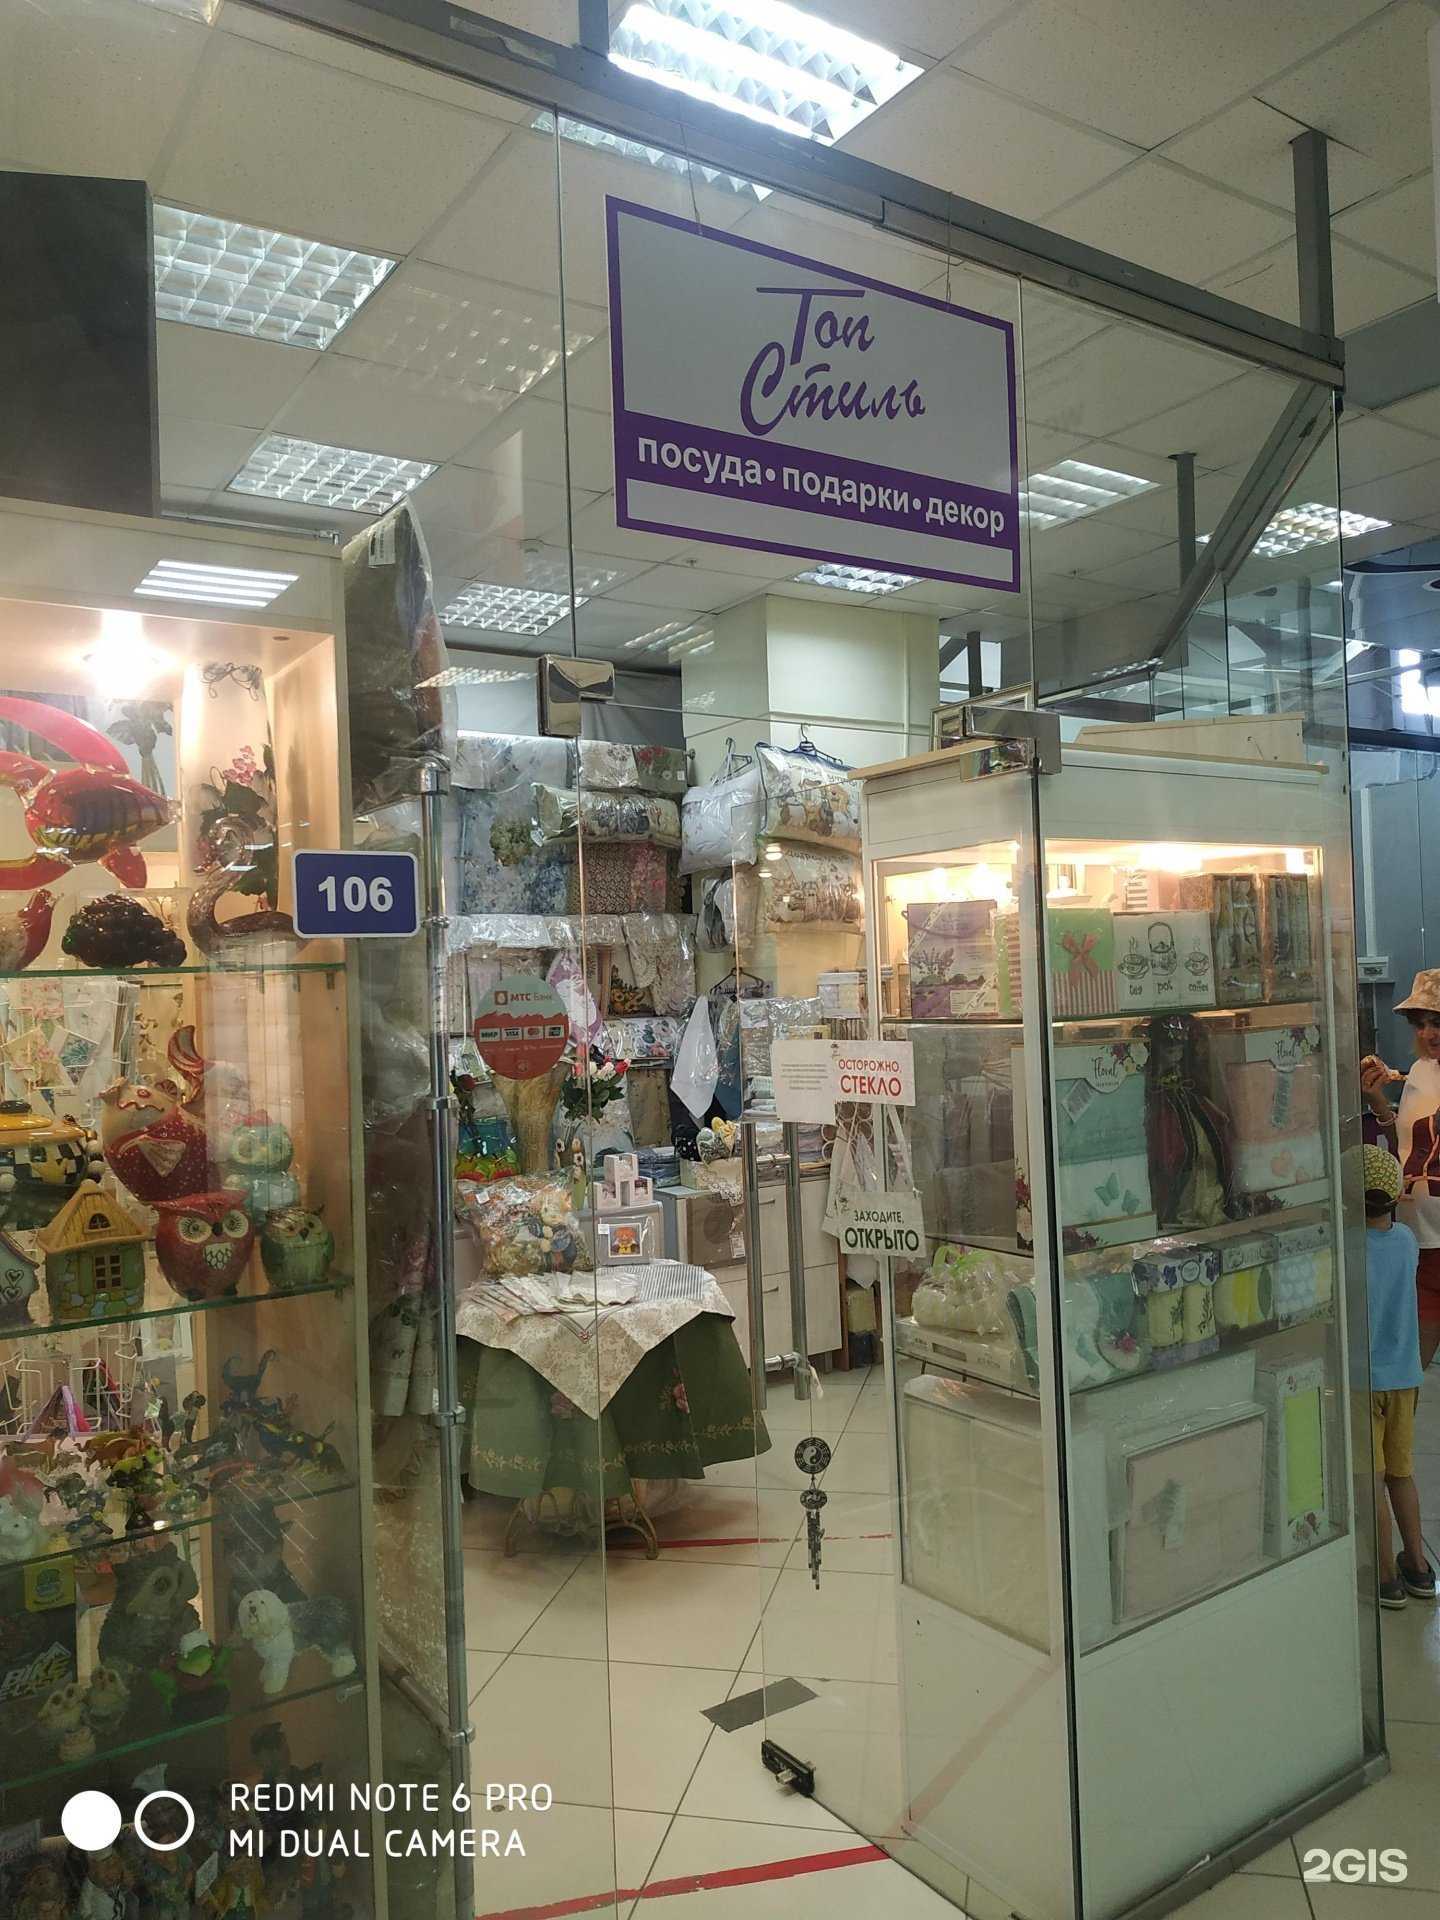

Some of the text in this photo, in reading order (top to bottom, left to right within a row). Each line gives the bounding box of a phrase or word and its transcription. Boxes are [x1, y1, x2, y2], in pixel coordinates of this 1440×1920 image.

[756, 287, 875, 366] Топ
[740, 342, 926, 437] Стиль
[925, 496, 1005, 537] декор
[318, 875, 394, 913] 106
[840, 1075, 902, 1097] СТЕКЛО
[844, 1227, 920, 1251] ОТКРЫТО
